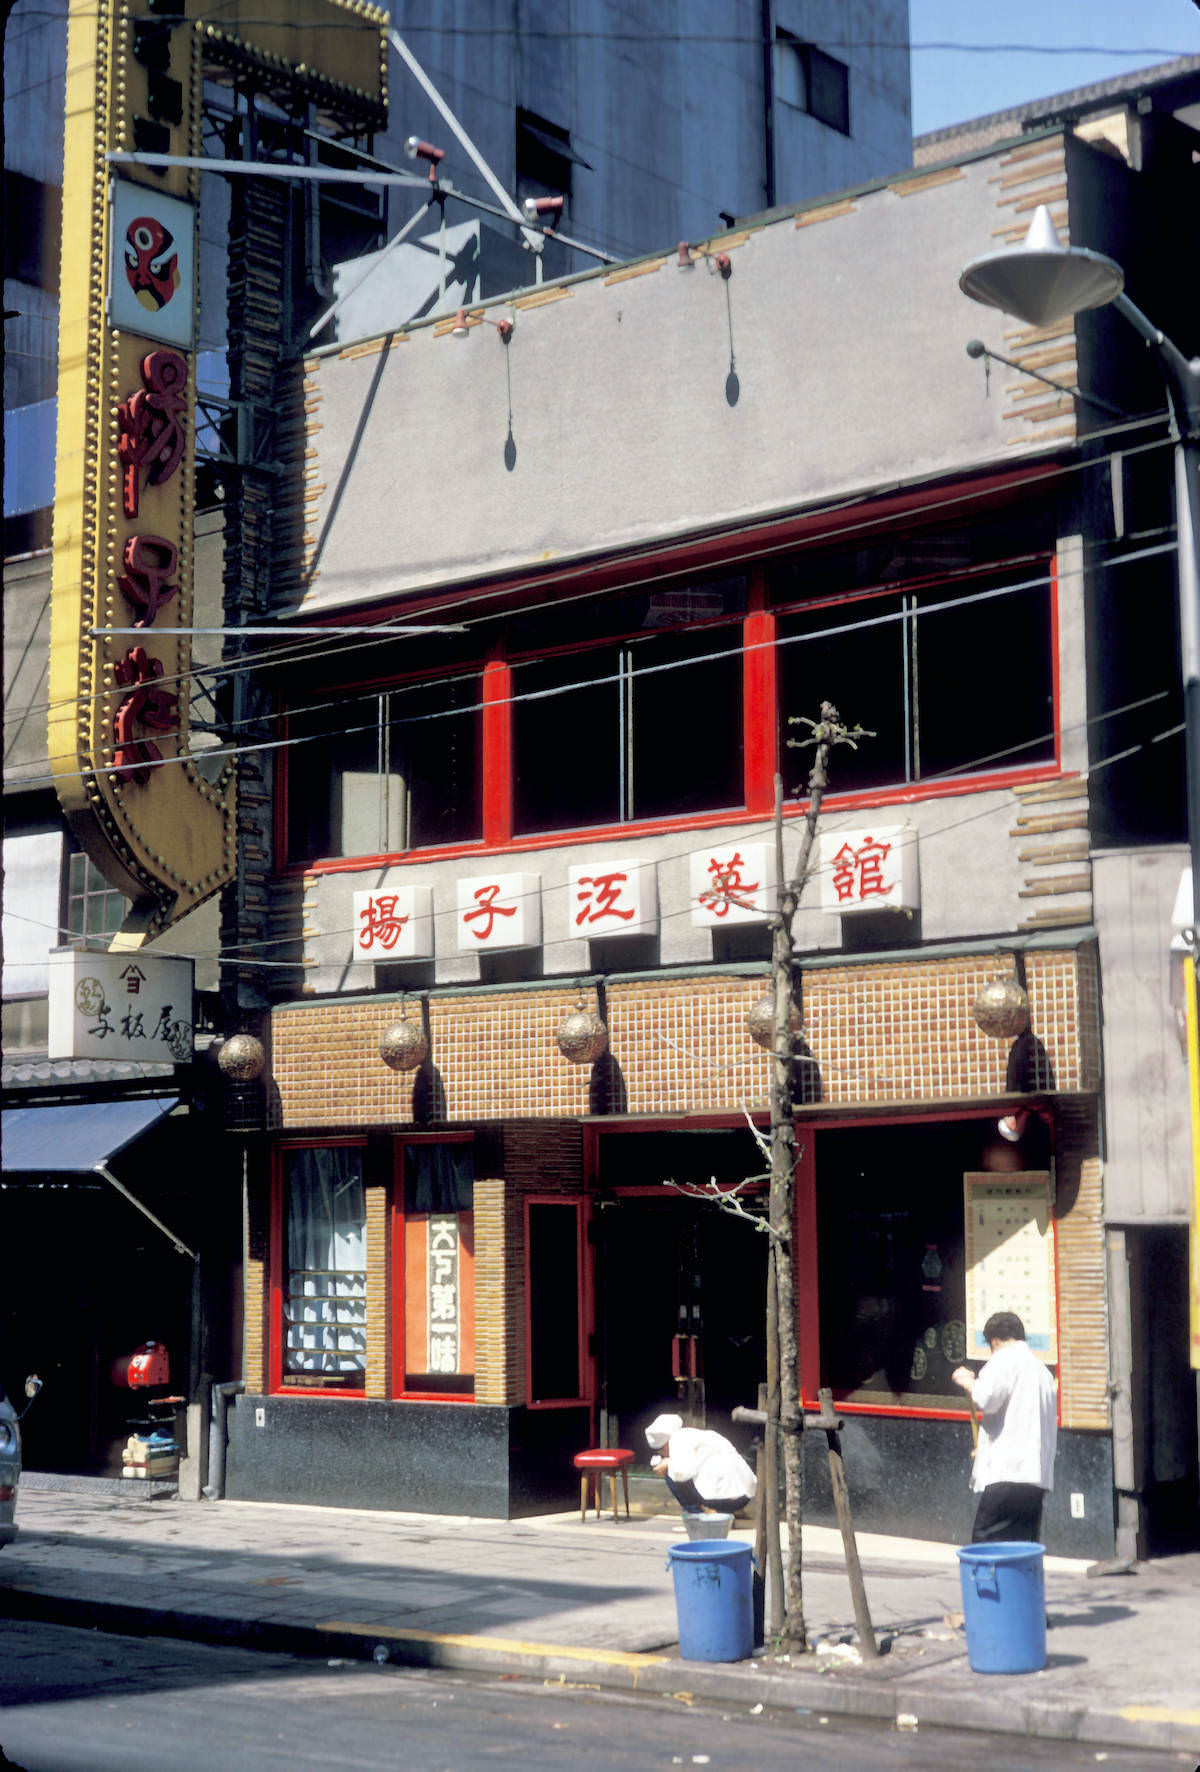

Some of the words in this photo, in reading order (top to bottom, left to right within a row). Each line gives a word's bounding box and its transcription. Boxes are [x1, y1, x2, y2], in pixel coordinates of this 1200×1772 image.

[359, 835, 895, 951] 揚子江菜館
